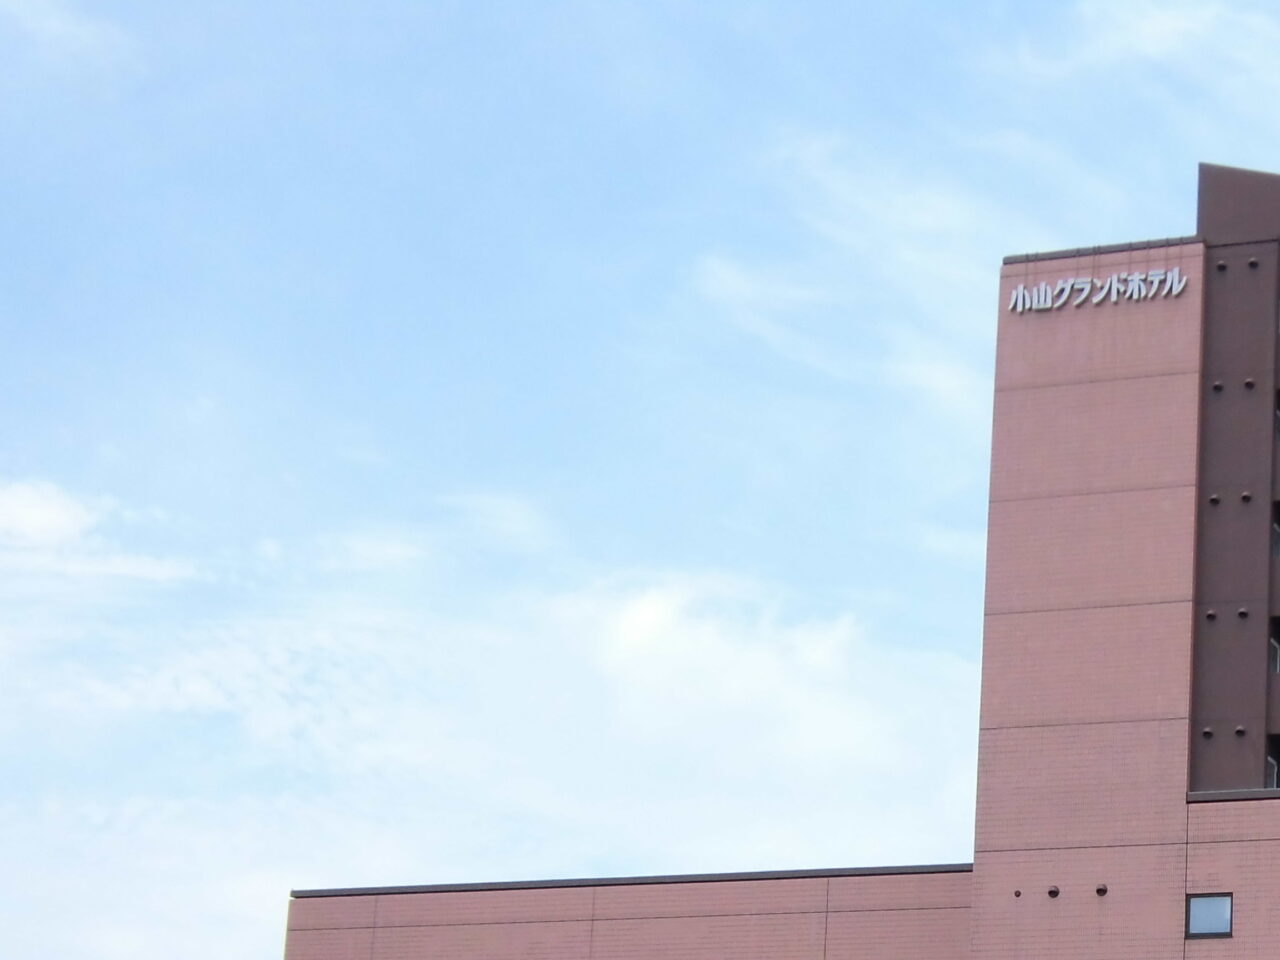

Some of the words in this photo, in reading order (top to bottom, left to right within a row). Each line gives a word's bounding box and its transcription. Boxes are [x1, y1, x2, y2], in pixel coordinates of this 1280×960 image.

[1008, 267, 1187, 313] 小山グランドホテル
